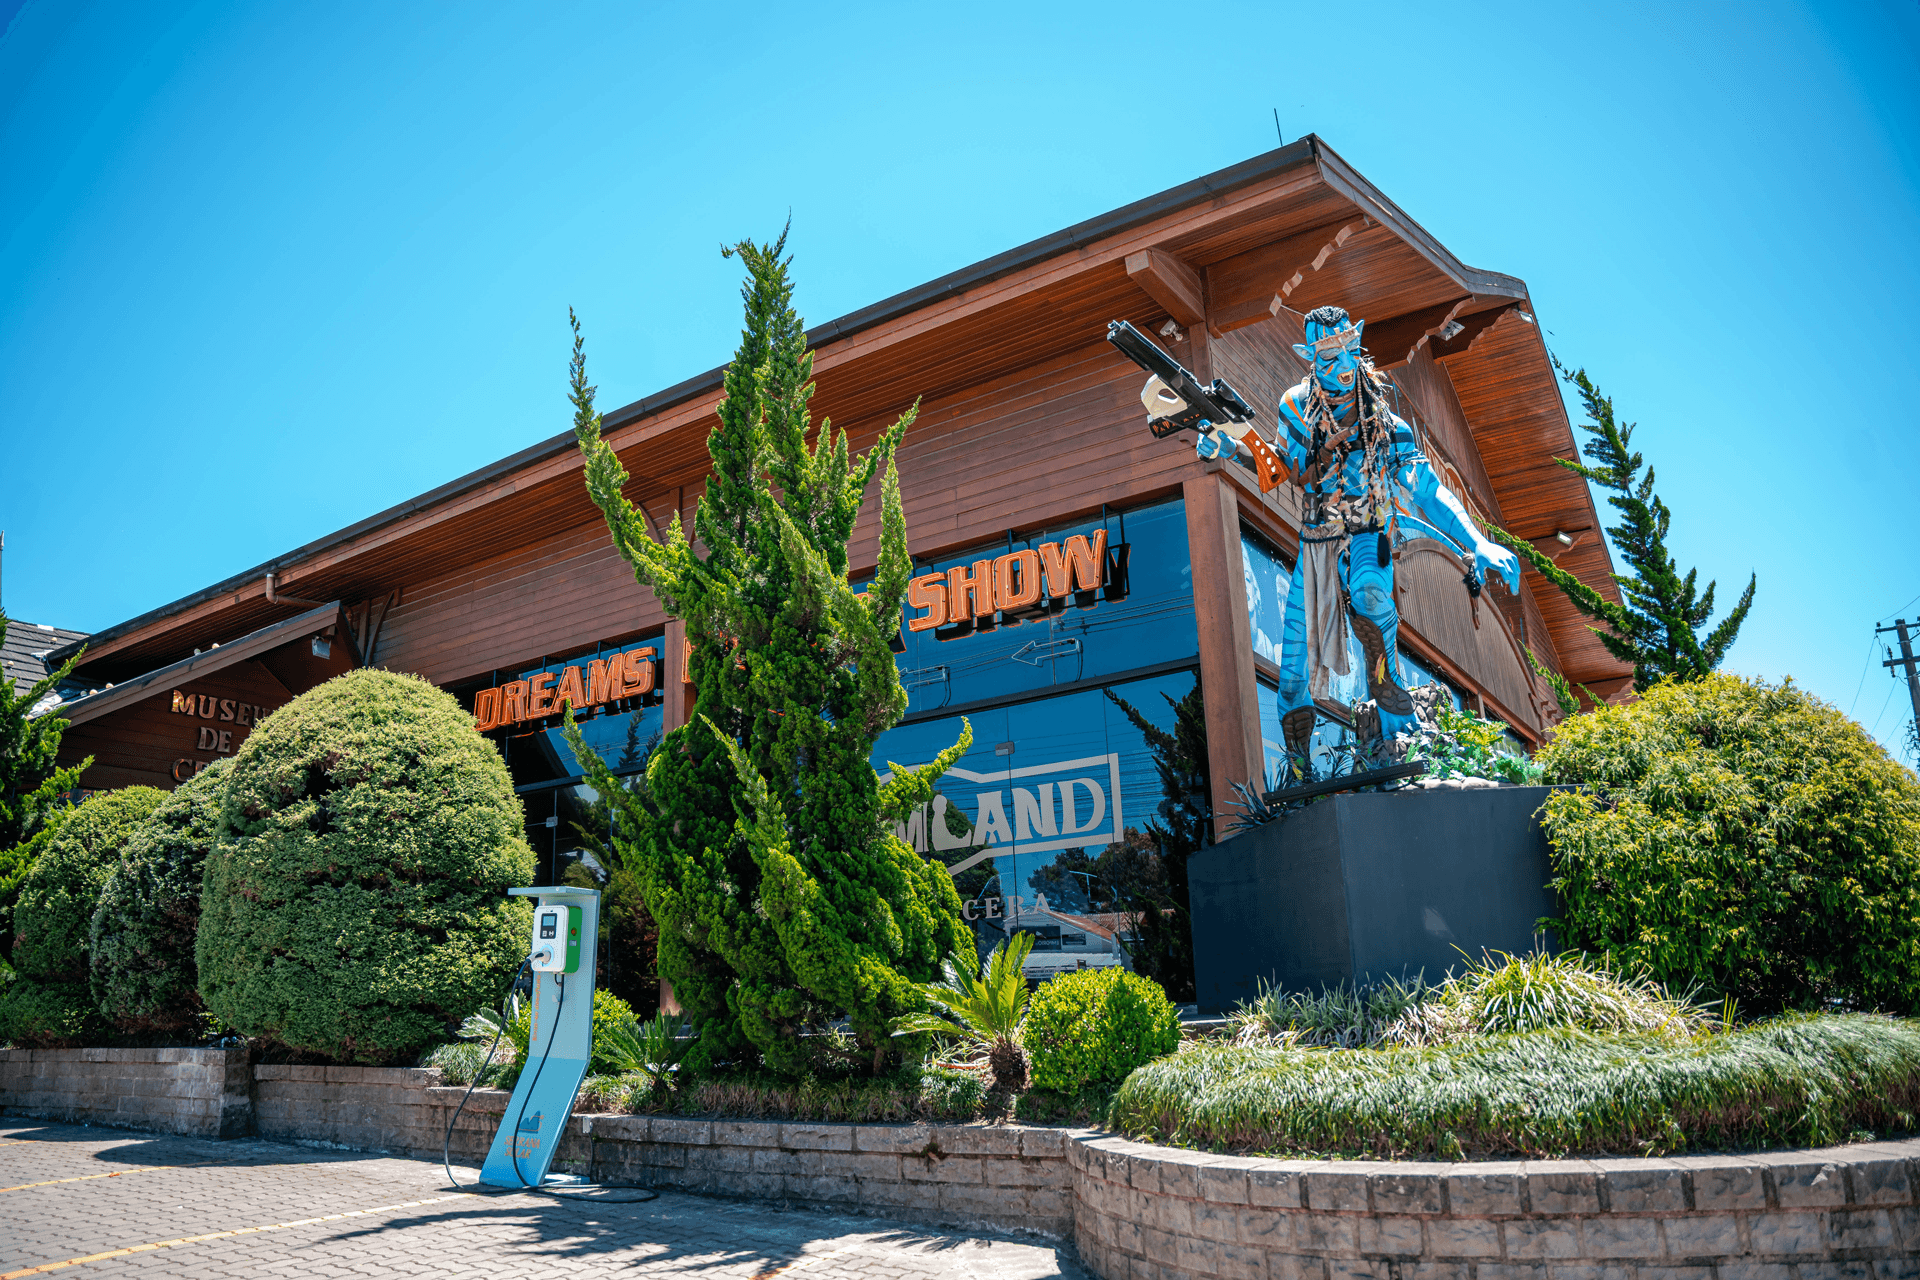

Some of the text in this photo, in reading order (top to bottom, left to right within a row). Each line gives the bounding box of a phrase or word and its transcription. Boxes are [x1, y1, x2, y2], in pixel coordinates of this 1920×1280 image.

[474, 529, 1108, 731] DREAMS SHOW
[197, 726, 232, 753] DE
[962, 892, 1051, 921] CERA
